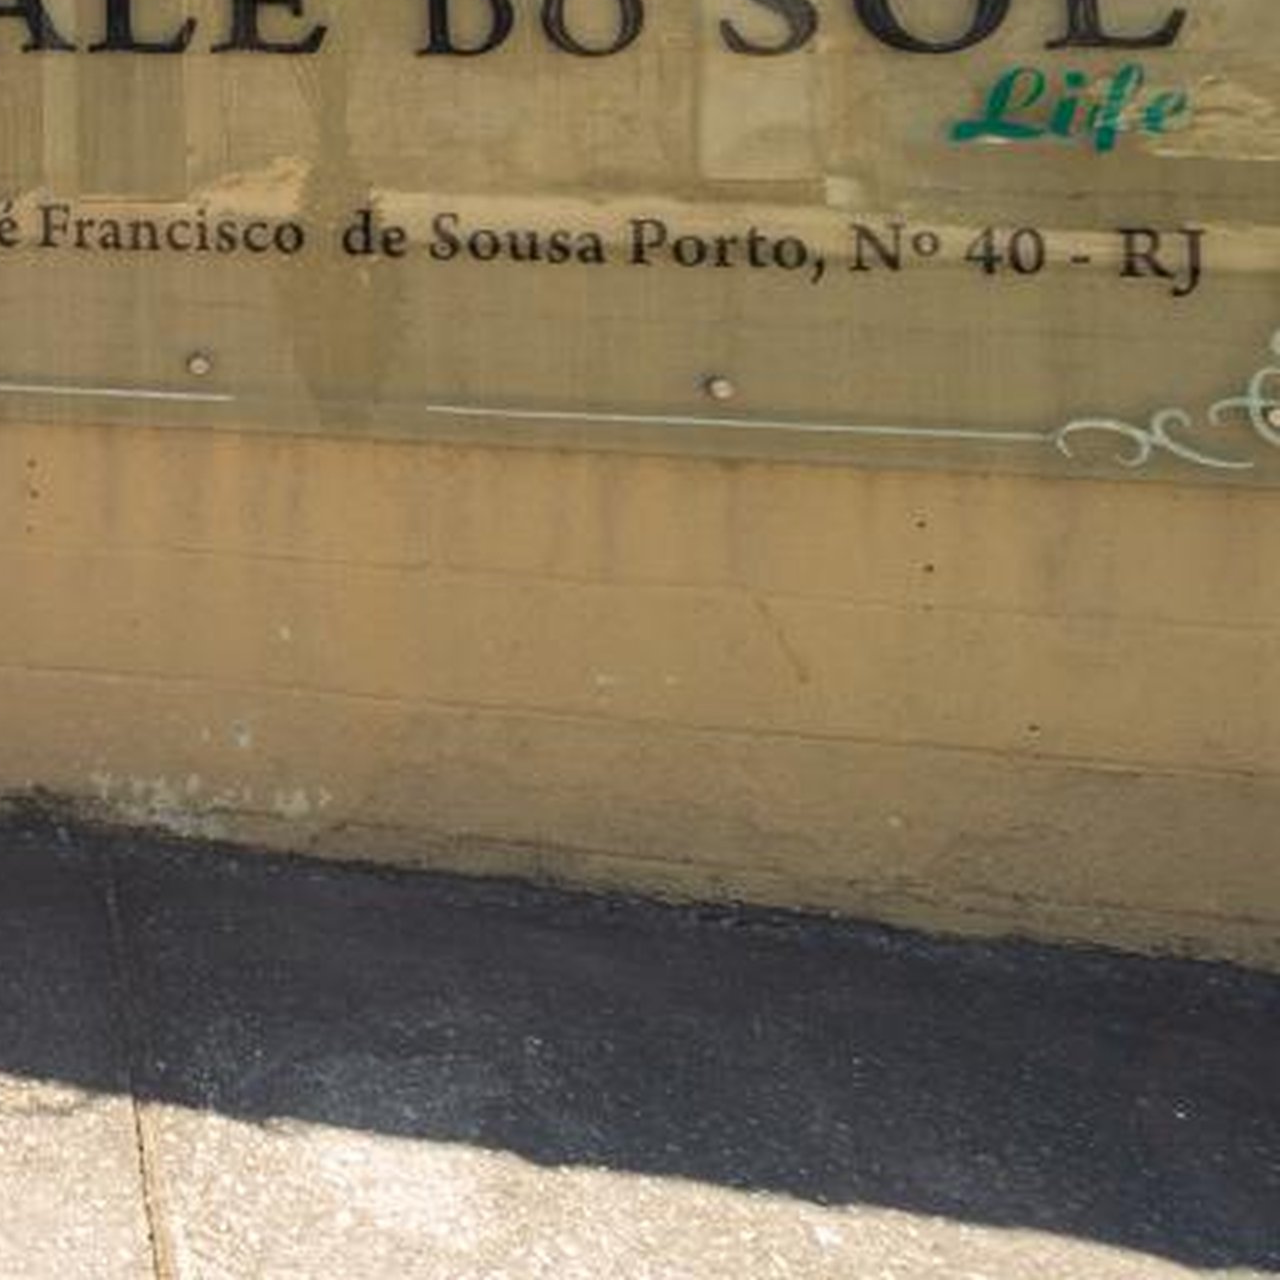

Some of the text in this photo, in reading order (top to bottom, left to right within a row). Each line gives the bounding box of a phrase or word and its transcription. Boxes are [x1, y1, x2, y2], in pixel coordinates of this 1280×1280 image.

[949, 64, 1190, 152] Life
[40, 205, 305, 254] Francisco
[342, 209, 406, 258] de
[429, 213, 606, 265] Sousa
[630, 219, 826, 284] Porto,
[966, 228, 1045, 275] 40
[1118, 227, 1207, 297] RJ
